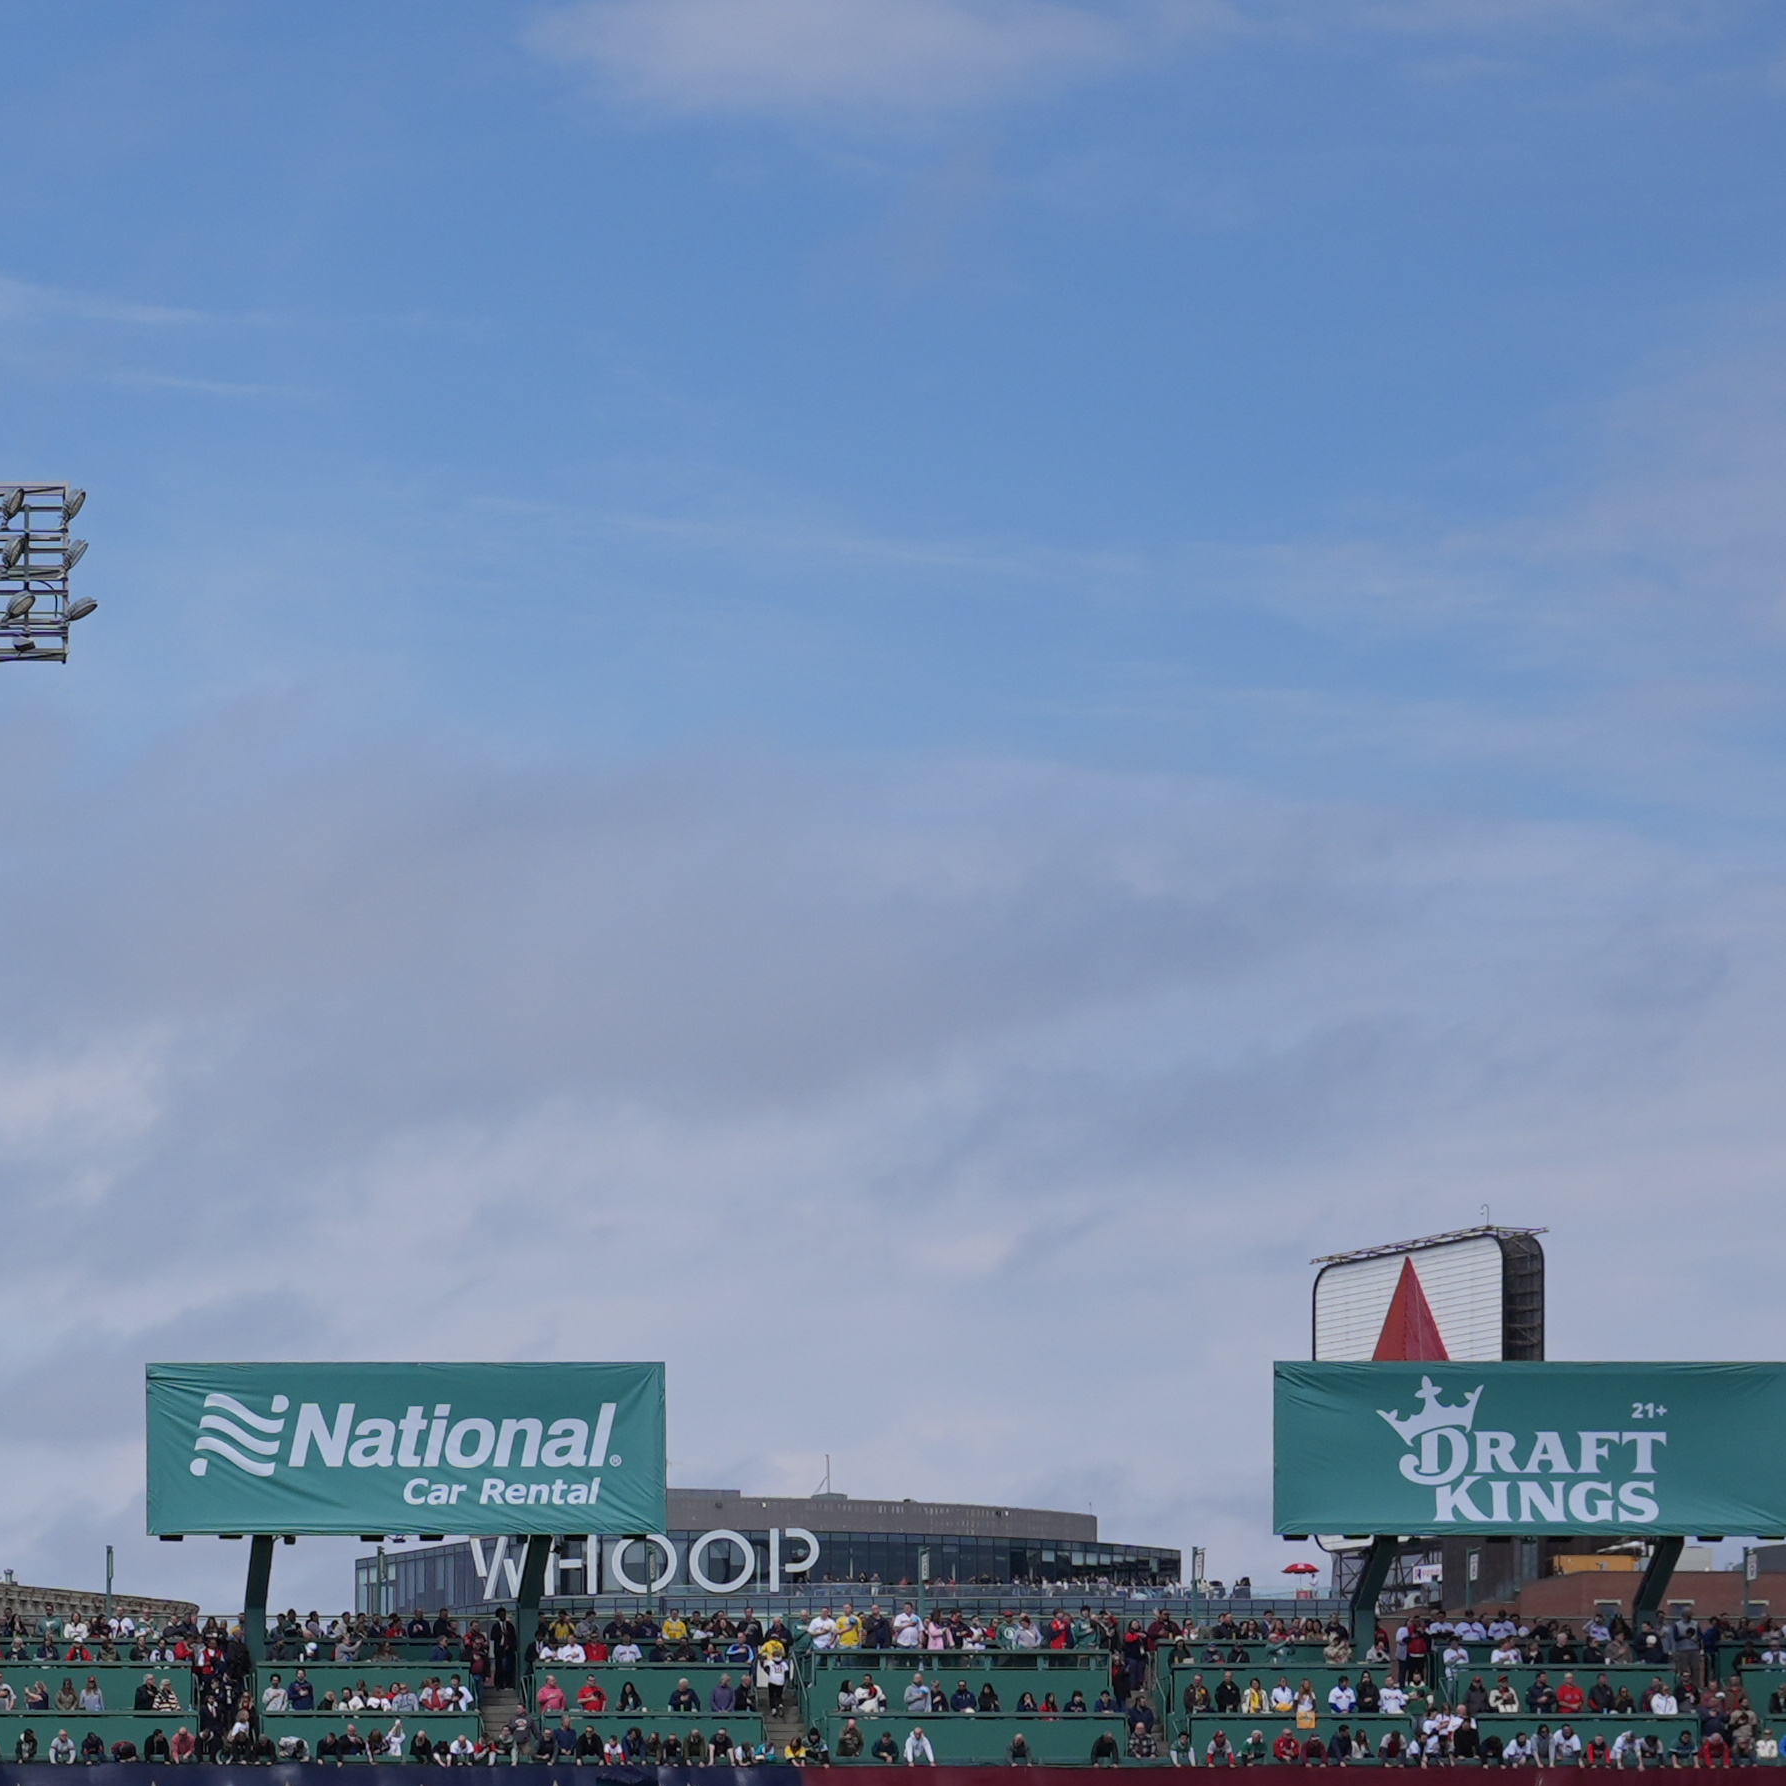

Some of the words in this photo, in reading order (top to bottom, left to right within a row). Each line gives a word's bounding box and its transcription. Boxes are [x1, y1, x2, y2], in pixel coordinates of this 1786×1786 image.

[287, 1402, 617, 1469] National
[1631, 1402, 1667, 1419] 21+
[1399, 1427, 1667, 1485] DRAFT
[402, 1477, 466, 1506] Car
[479, 1477, 601, 1506] Rental
[1432, 1475, 1660, 1523] KINGS
[470, 1528, 820, 1600] WHOOP
